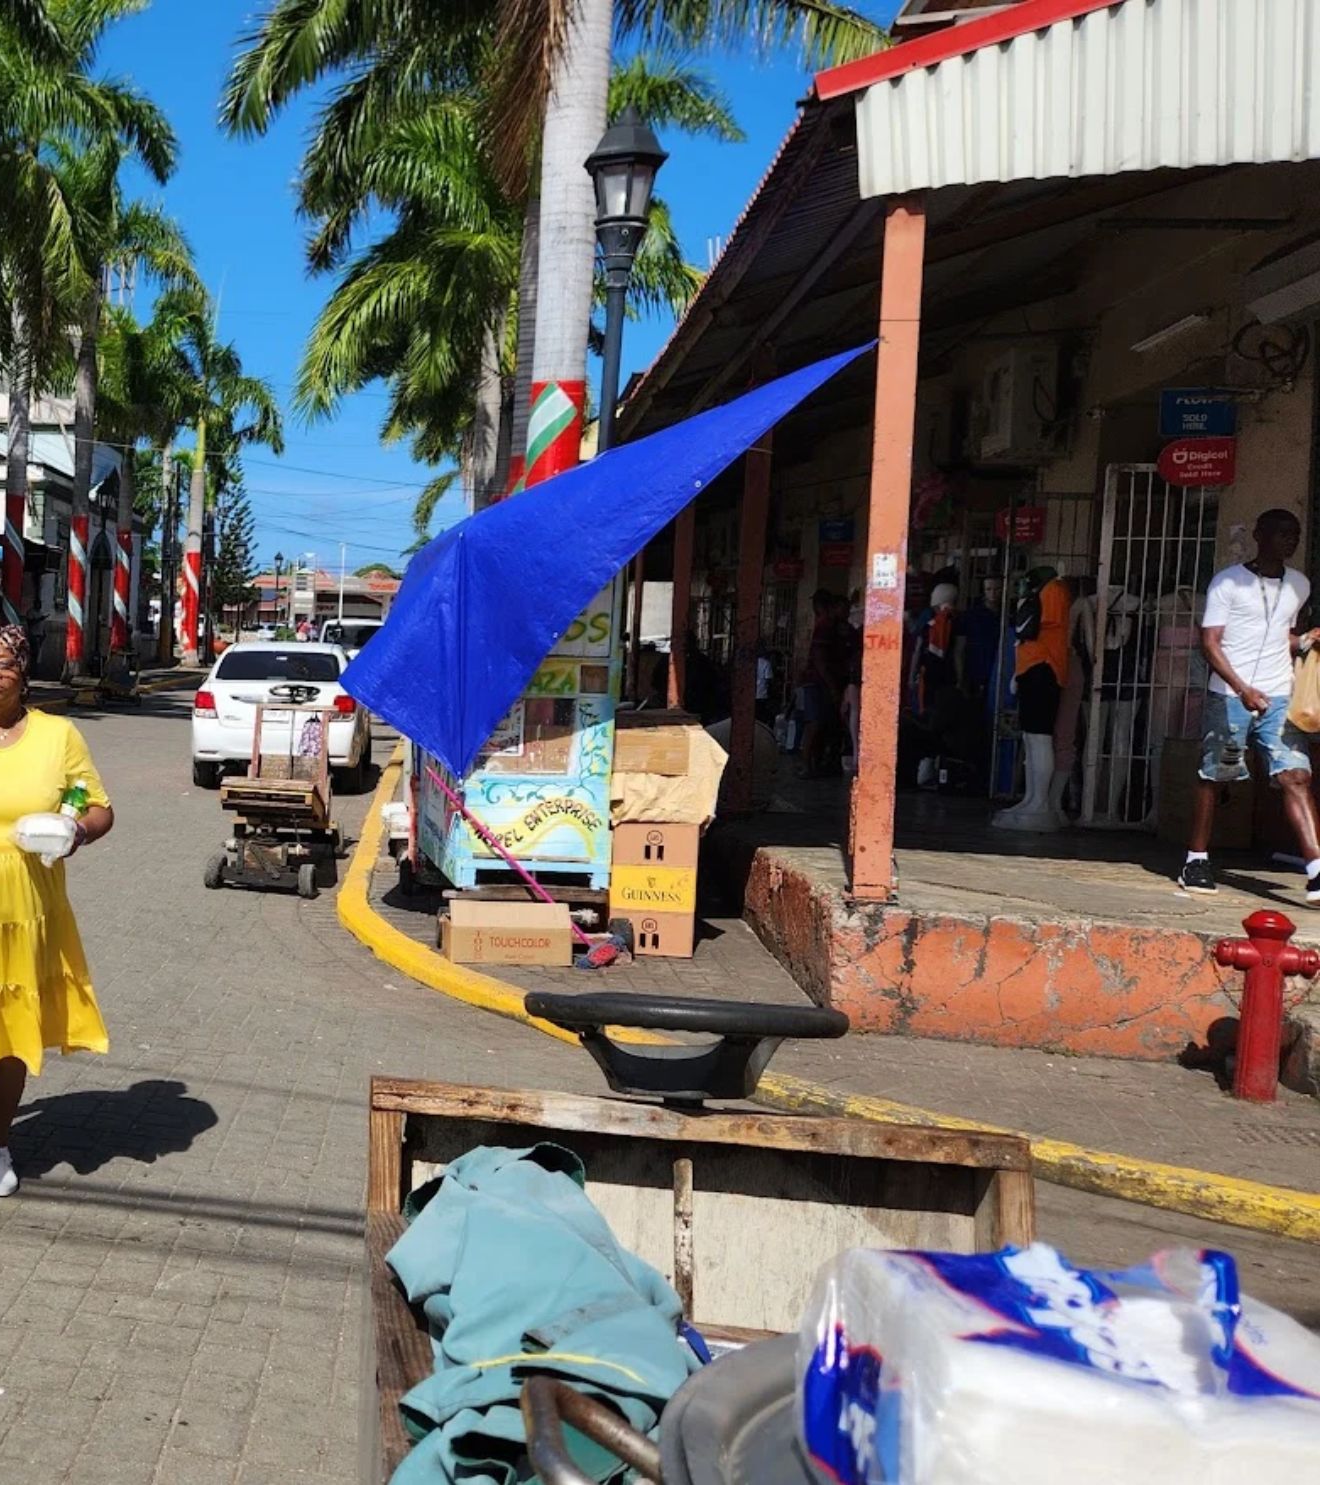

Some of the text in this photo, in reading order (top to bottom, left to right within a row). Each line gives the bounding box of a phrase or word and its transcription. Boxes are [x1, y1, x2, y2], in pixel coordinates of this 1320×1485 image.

[1189, 449, 1229, 462] Digicel
[523, 798, 603, 832] ENTERPRISE
[621, 886, 683, 904] GUINNESS
